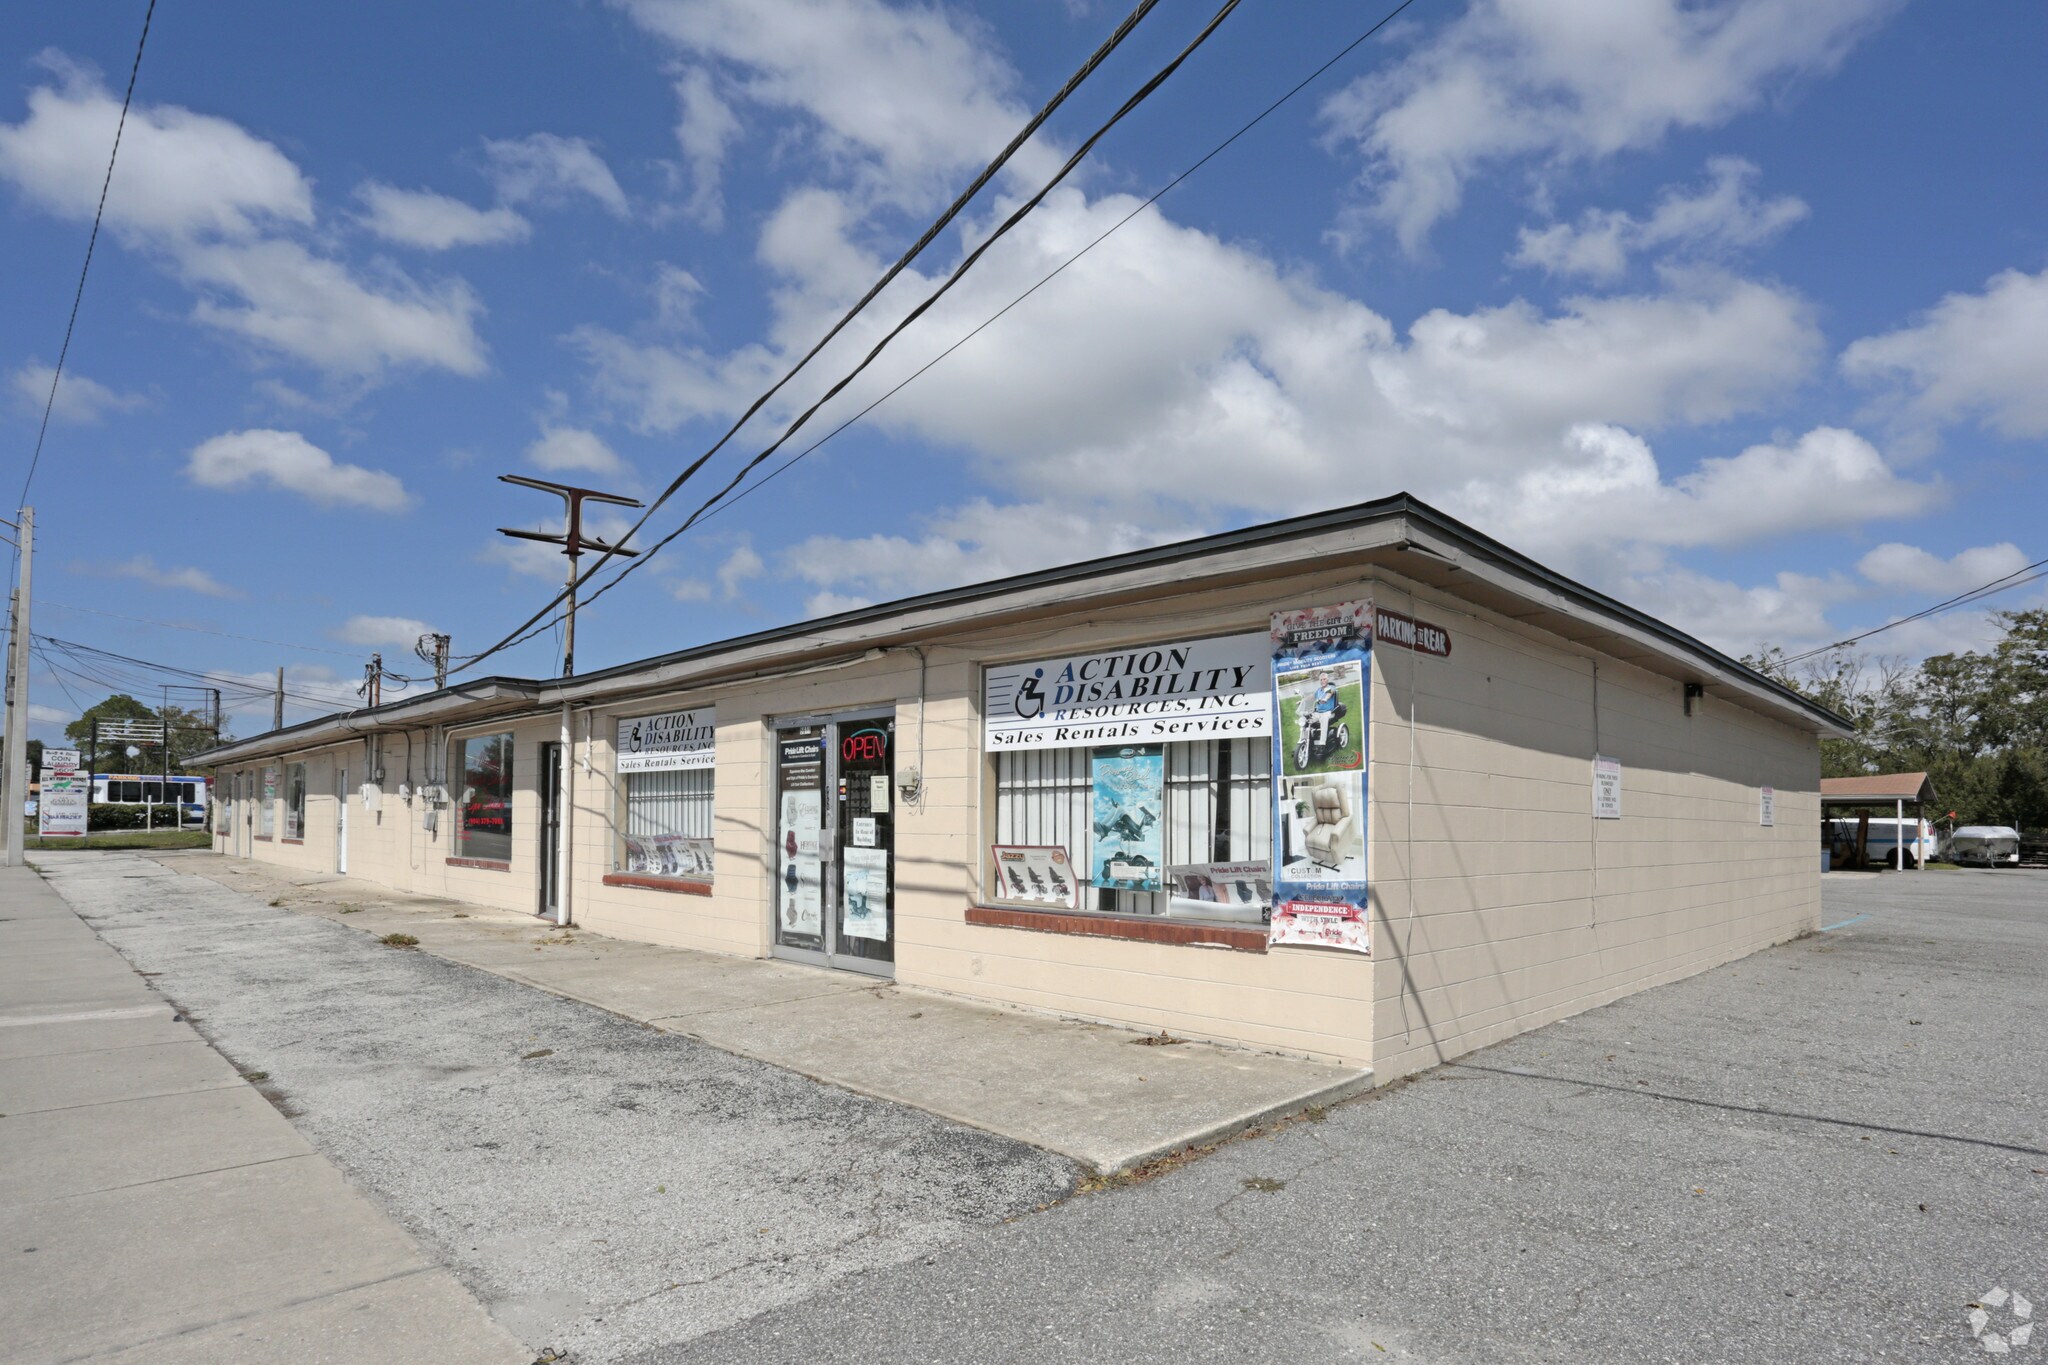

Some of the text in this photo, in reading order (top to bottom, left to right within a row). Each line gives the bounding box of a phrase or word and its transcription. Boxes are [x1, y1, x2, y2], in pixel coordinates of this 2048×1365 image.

[1326, 616, 1342, 625] GIFT
[1343, 615, 1354, 623] OF
[1293, 626, 1348, 642] FREEDOM
[1377, 614, 1417, 645] PARKING
[1423, 627, 1447, 655] REAR
[1054, 647, 1192, 684] ACTION
[1052, 665, 1255, 705] DISABILITY
[1055, 692, 1250, 720] RESOURCES, INC.
[645, 712, 696, 732] ACTION
[992, 715, 1264, 745] Sales Rentals Services
[644, 725, 715, 745] DISABILITY
[804, 745, 819, 754] Chairs
[842, 735, 884, 761] OPEN
[620, 755, 715, 769] Sales Rentals Service
[1242, 865, 1267, 873] Chairs
[1306, 882, 1366, 890] Pride Lift Chairs
[1291, 903, 1348, 915] INDEPENDENCE
[1320, 916, 1338, 924] STYLE
[1325, 928, 1343, 936] Pride
